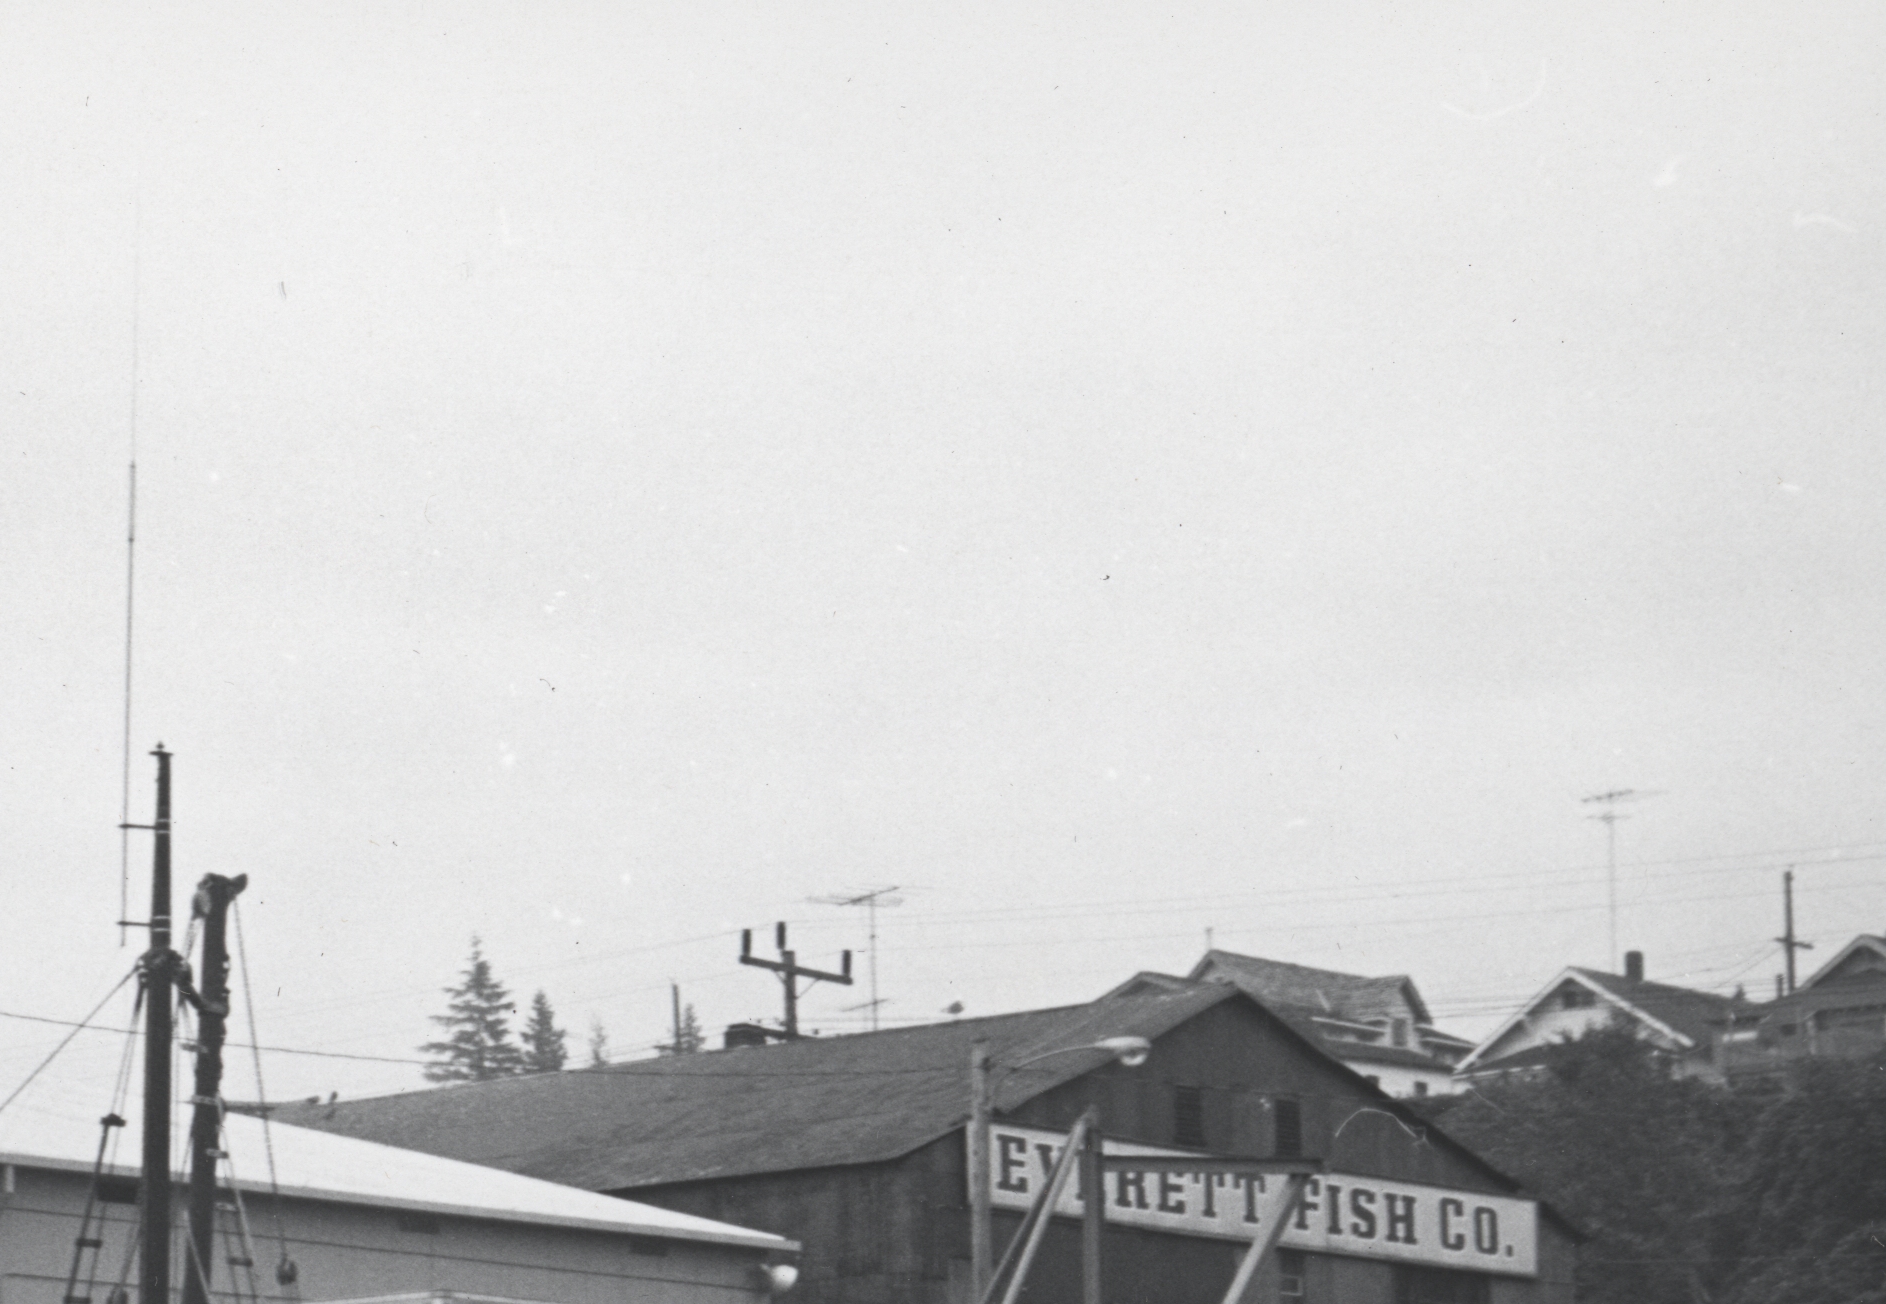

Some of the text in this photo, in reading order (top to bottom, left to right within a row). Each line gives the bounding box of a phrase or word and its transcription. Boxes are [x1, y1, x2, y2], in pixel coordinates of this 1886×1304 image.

[996, 1133, 1514, 1258] EVRETT FISH CO.
